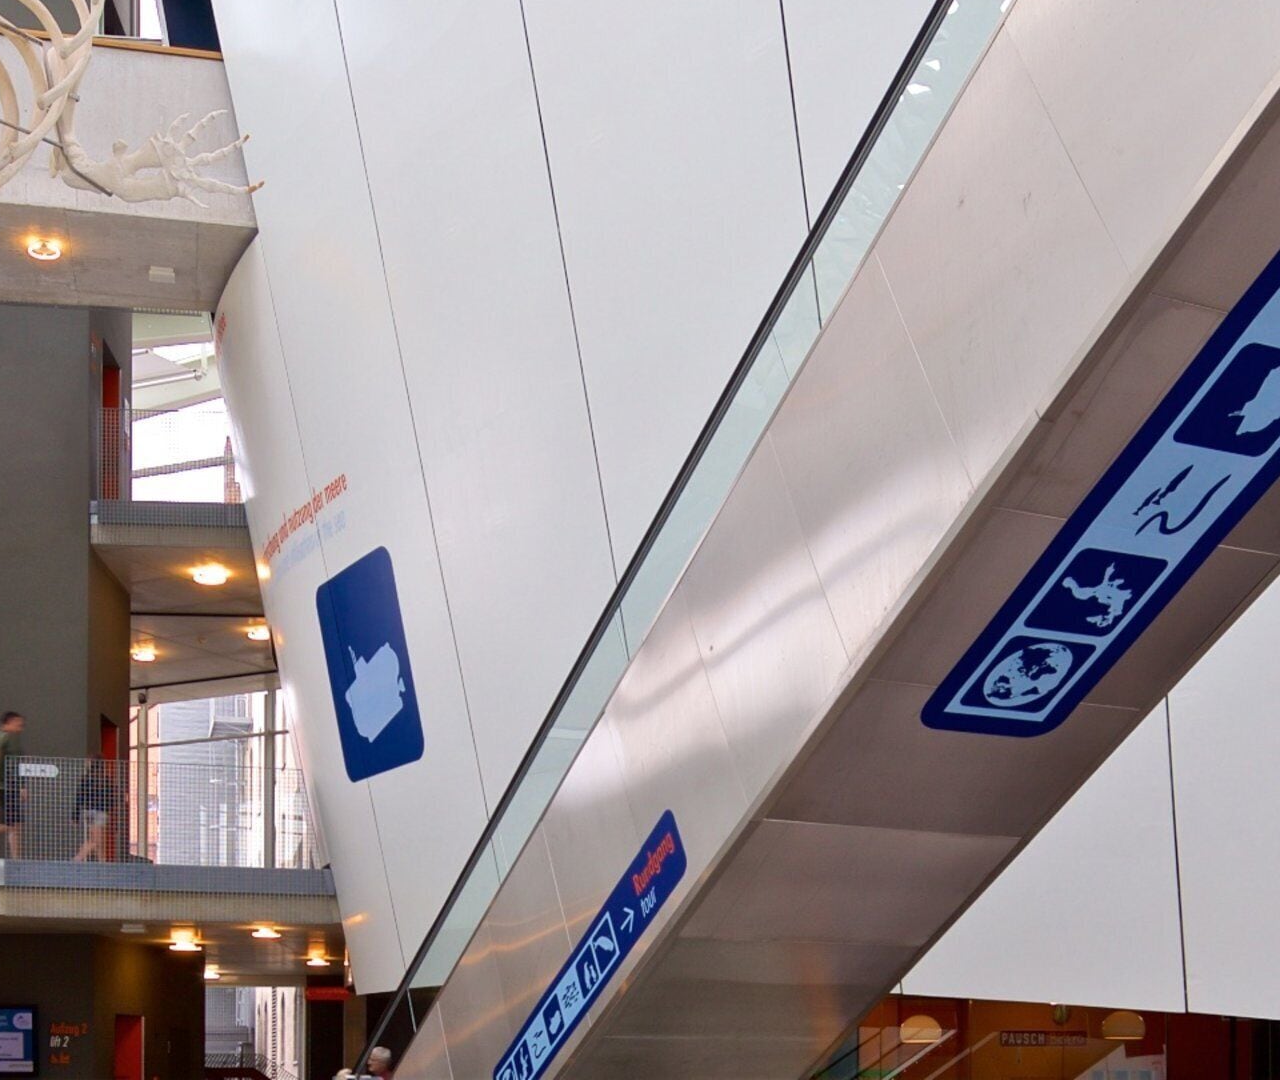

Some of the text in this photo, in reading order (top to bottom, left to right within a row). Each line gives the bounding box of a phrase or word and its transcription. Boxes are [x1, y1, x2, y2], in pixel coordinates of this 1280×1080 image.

[632, 832, 675, 896] Rundgang
[640, 886, 656, 918] tour
[62, 1035, 70, 1048] 2
[1002, 1033, 1045, 1045] PAUSCH
